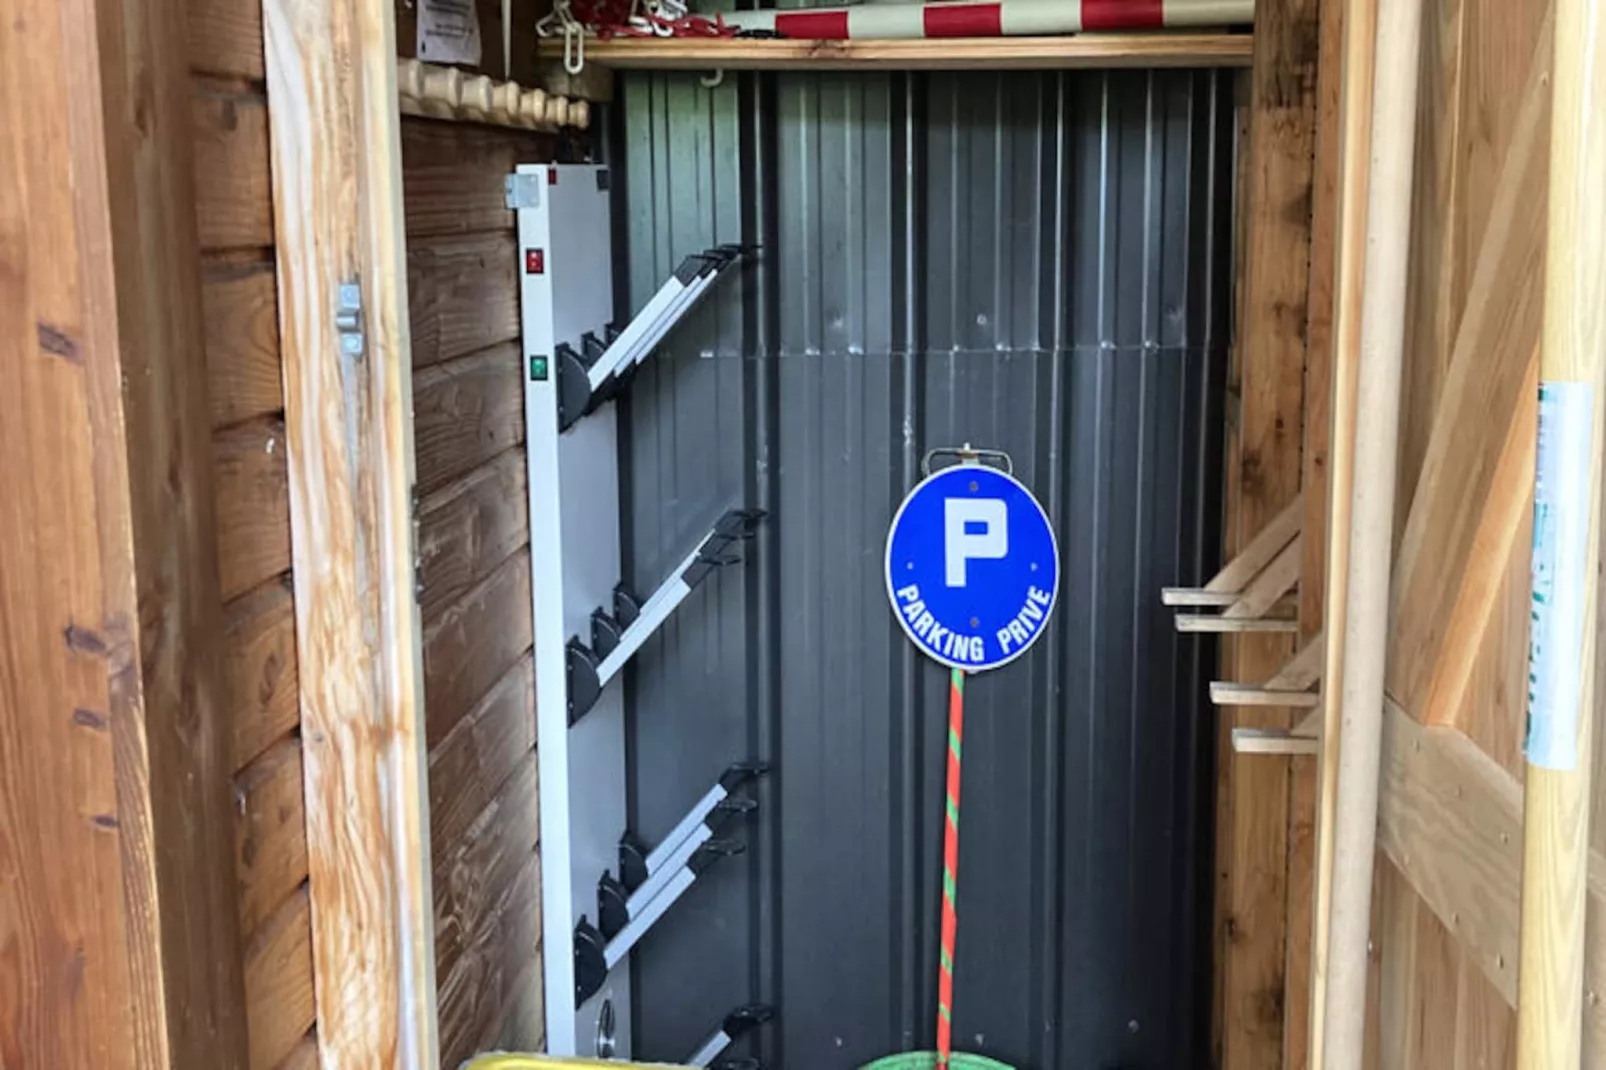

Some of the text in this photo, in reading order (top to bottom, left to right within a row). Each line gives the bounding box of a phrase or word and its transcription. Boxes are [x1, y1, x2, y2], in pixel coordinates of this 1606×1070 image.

[944, 498, 1008, 588] P
[897, 584, 1051, 662] PARKING PRIVE
